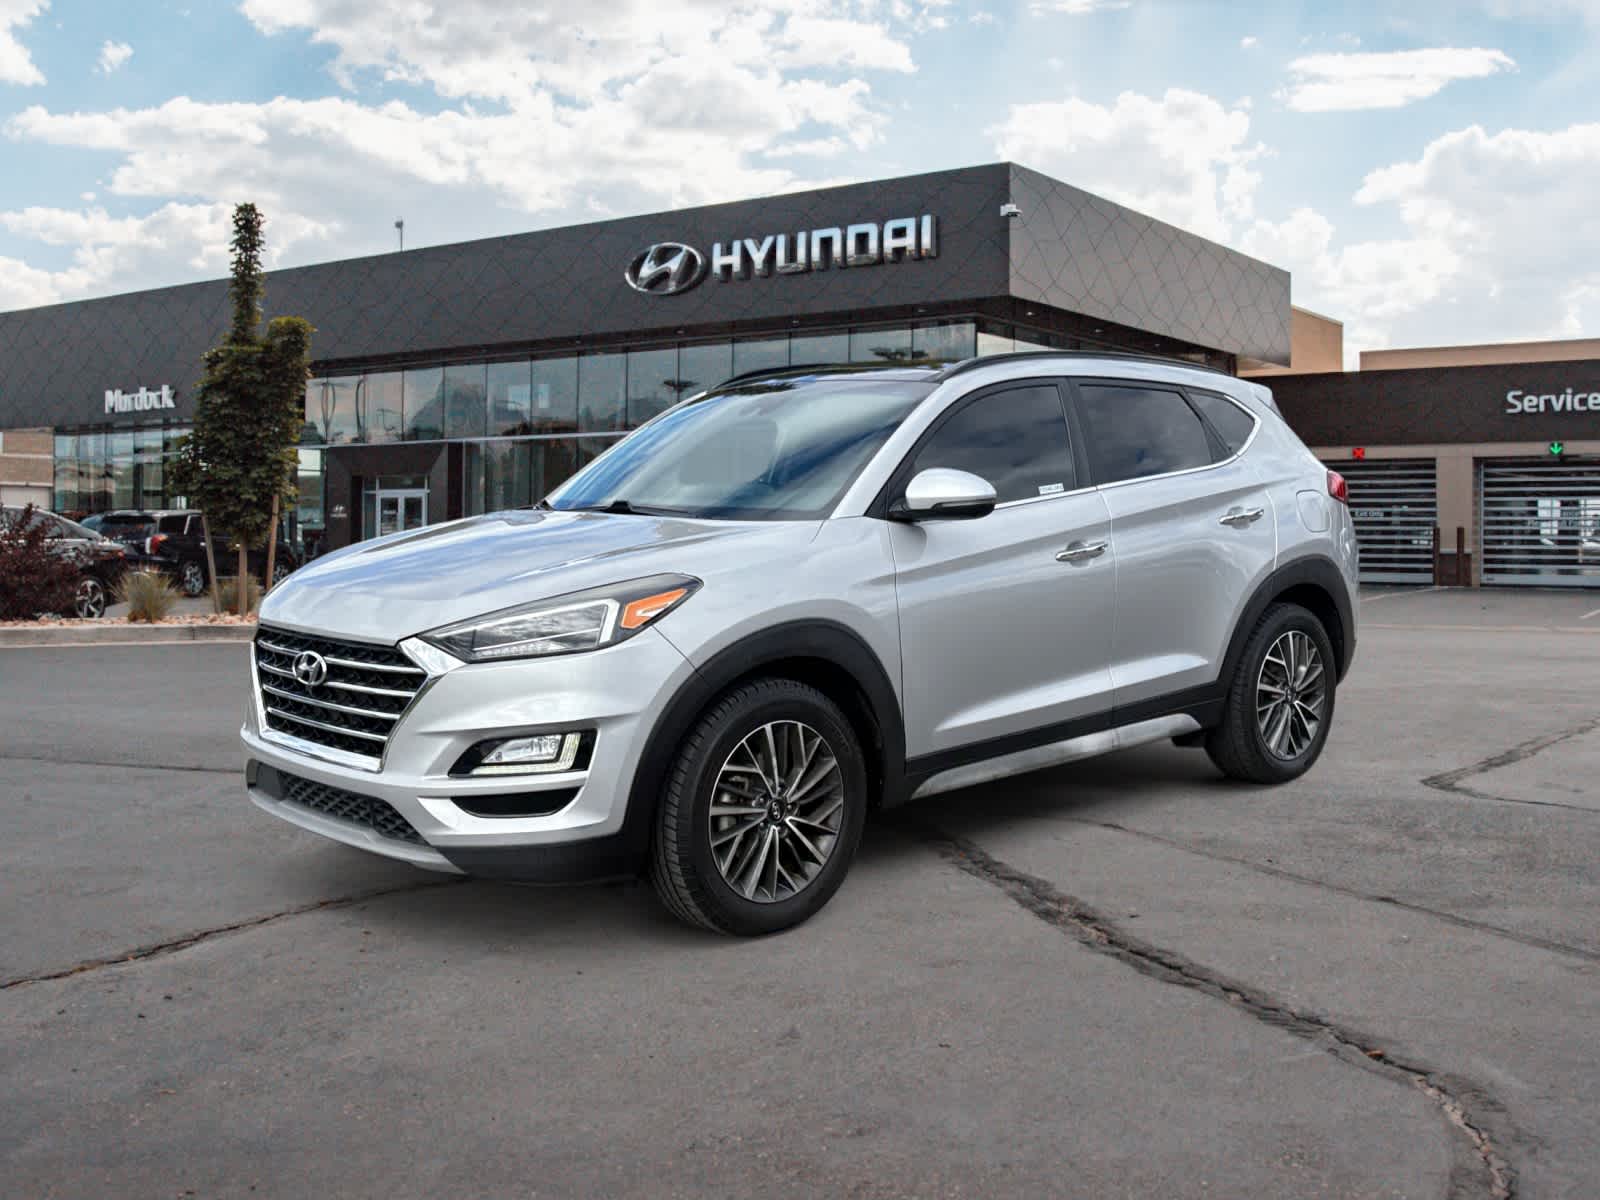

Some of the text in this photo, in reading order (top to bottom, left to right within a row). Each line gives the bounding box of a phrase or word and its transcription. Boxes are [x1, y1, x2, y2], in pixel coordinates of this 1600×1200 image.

[711, 213, 938, 283] HYUNDAI
[104, 384, 176, 414] Murdock
[1505, 387, 1600, 414] Service
